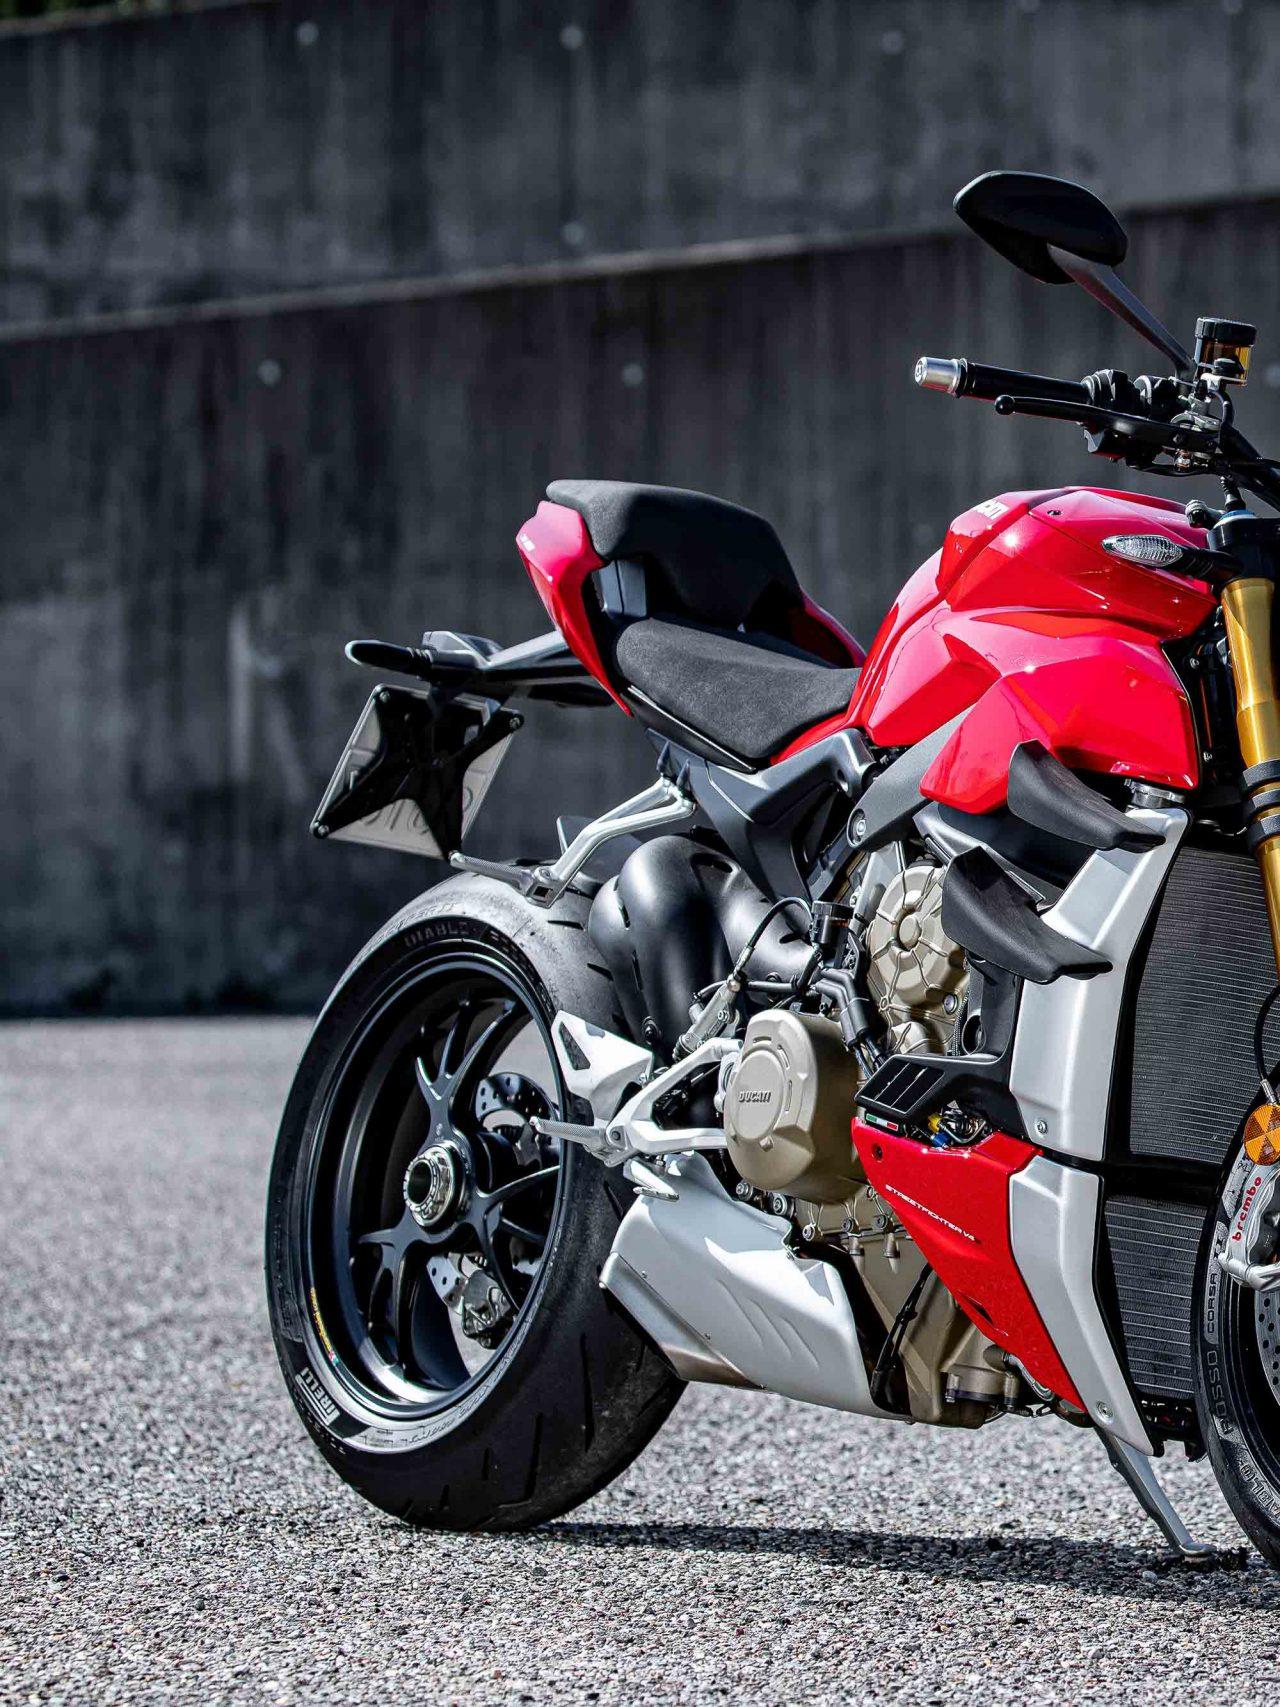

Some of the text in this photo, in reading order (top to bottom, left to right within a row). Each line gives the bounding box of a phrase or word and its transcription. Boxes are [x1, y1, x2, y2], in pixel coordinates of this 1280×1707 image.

[739, 1090, 771, 1103] DUCATI
[885, 1184, 975, 1241] STREETFIGHTER V4
[1232, 1176, 1262, 1241] brembo
[1207, 1273, 1218, 1334] CORSA
[295, 1367, 341, 1427] PIRELLI
[1206, 1350, 1234, 1435] ROSSO
